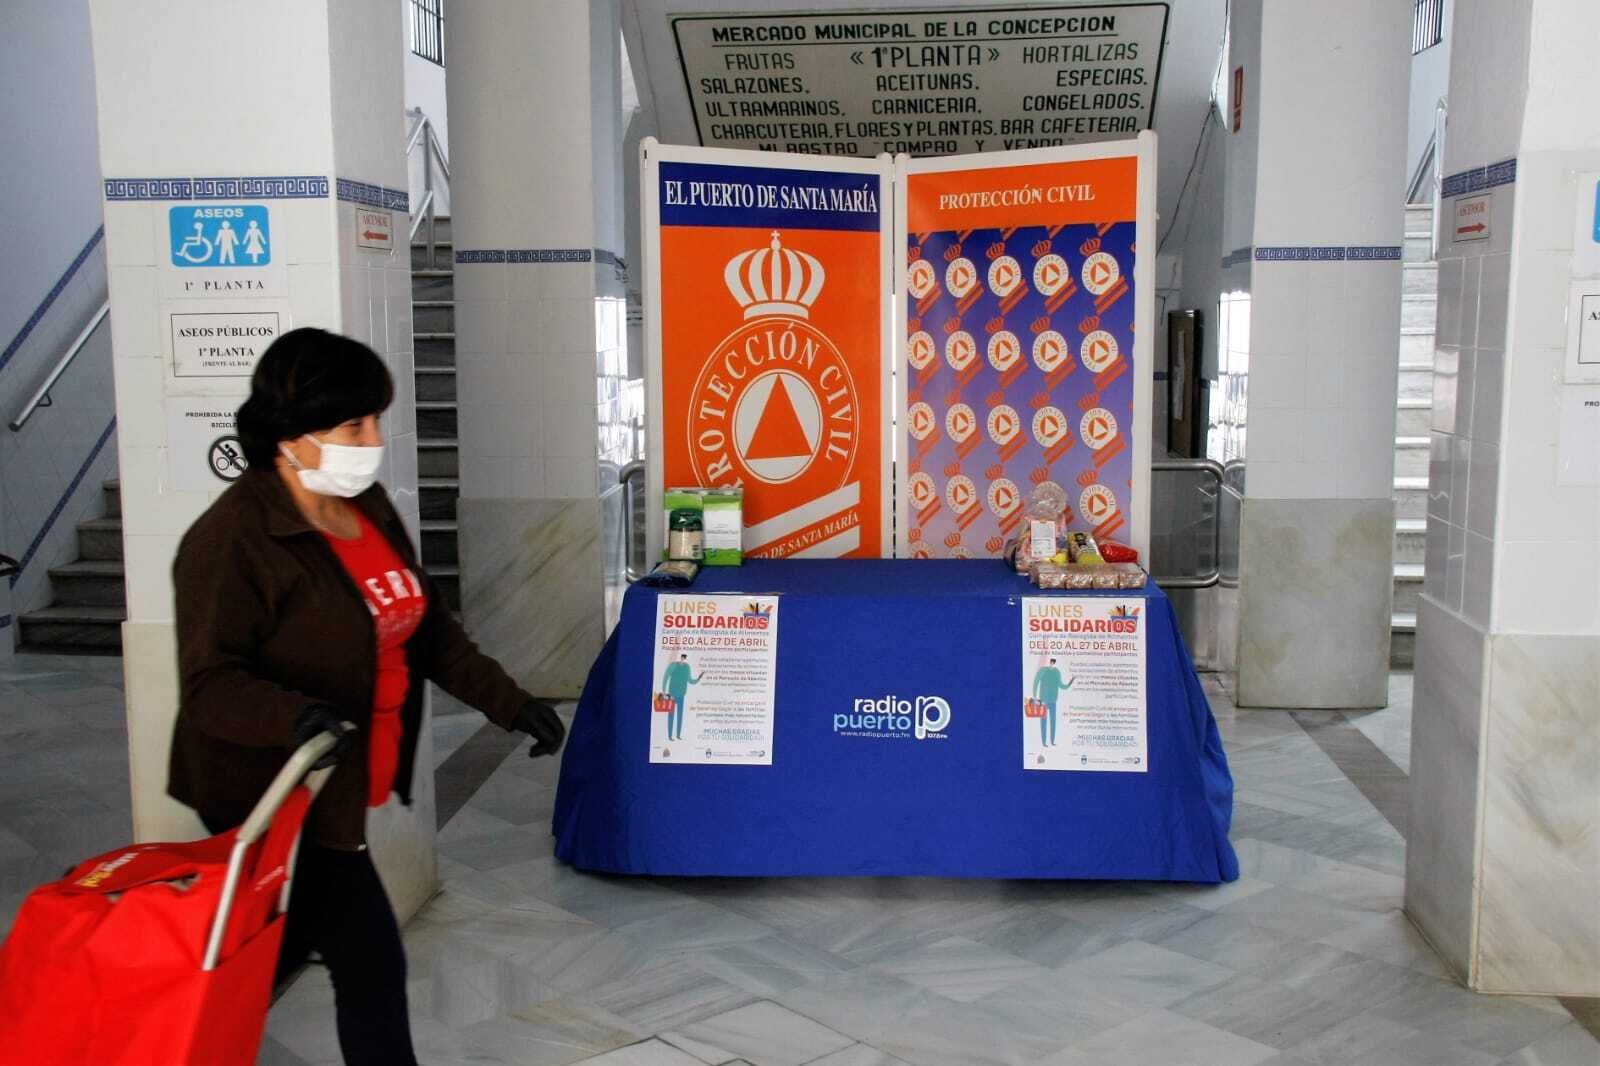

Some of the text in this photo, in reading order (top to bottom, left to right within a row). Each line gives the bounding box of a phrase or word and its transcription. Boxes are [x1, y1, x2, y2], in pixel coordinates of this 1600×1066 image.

[712, 16, 1116, 42] MERCADO MUNICIPAL DE LA CONCEPCION
[1022, 43, 1139, 64] HORTALIZAS
[724, 52, 796, 71] FRUTAS
[976, 140, 985, 152] Y
[665, 181, 878, 213] EL PUERTO DE SANTA MARÍA
[939, 184, 1095, 210] PROTECCIÓN CIVIL
[194, 208, 244, 218] ASEOS
[204, 280, 264, 291] PLANTA
[178, 325, 274, 338] ASEOS PÚBLICOS
[210, 347, 255, 357] PLANTA
[820, 365, 852, 461] CIVIL
[771, 510, 859, 558] DE SANTA MARÍA
[663, 601, 717, 615] LUNES
[1028, 604, 1083, 618] LUNES
[663, 615, 768, 630] SOLIDARIOS
[1029, 619, 1137, 633] SOLIDARIOS
[662, 637, 768, 647] DEL 20 AL 27 DE ABRIL
[1029, 641, 1137, 651] DEL 20 AL 27 DE ABRIL
[854, 695, 912, 714] radio
[833, 713, 912, 732] puerto
